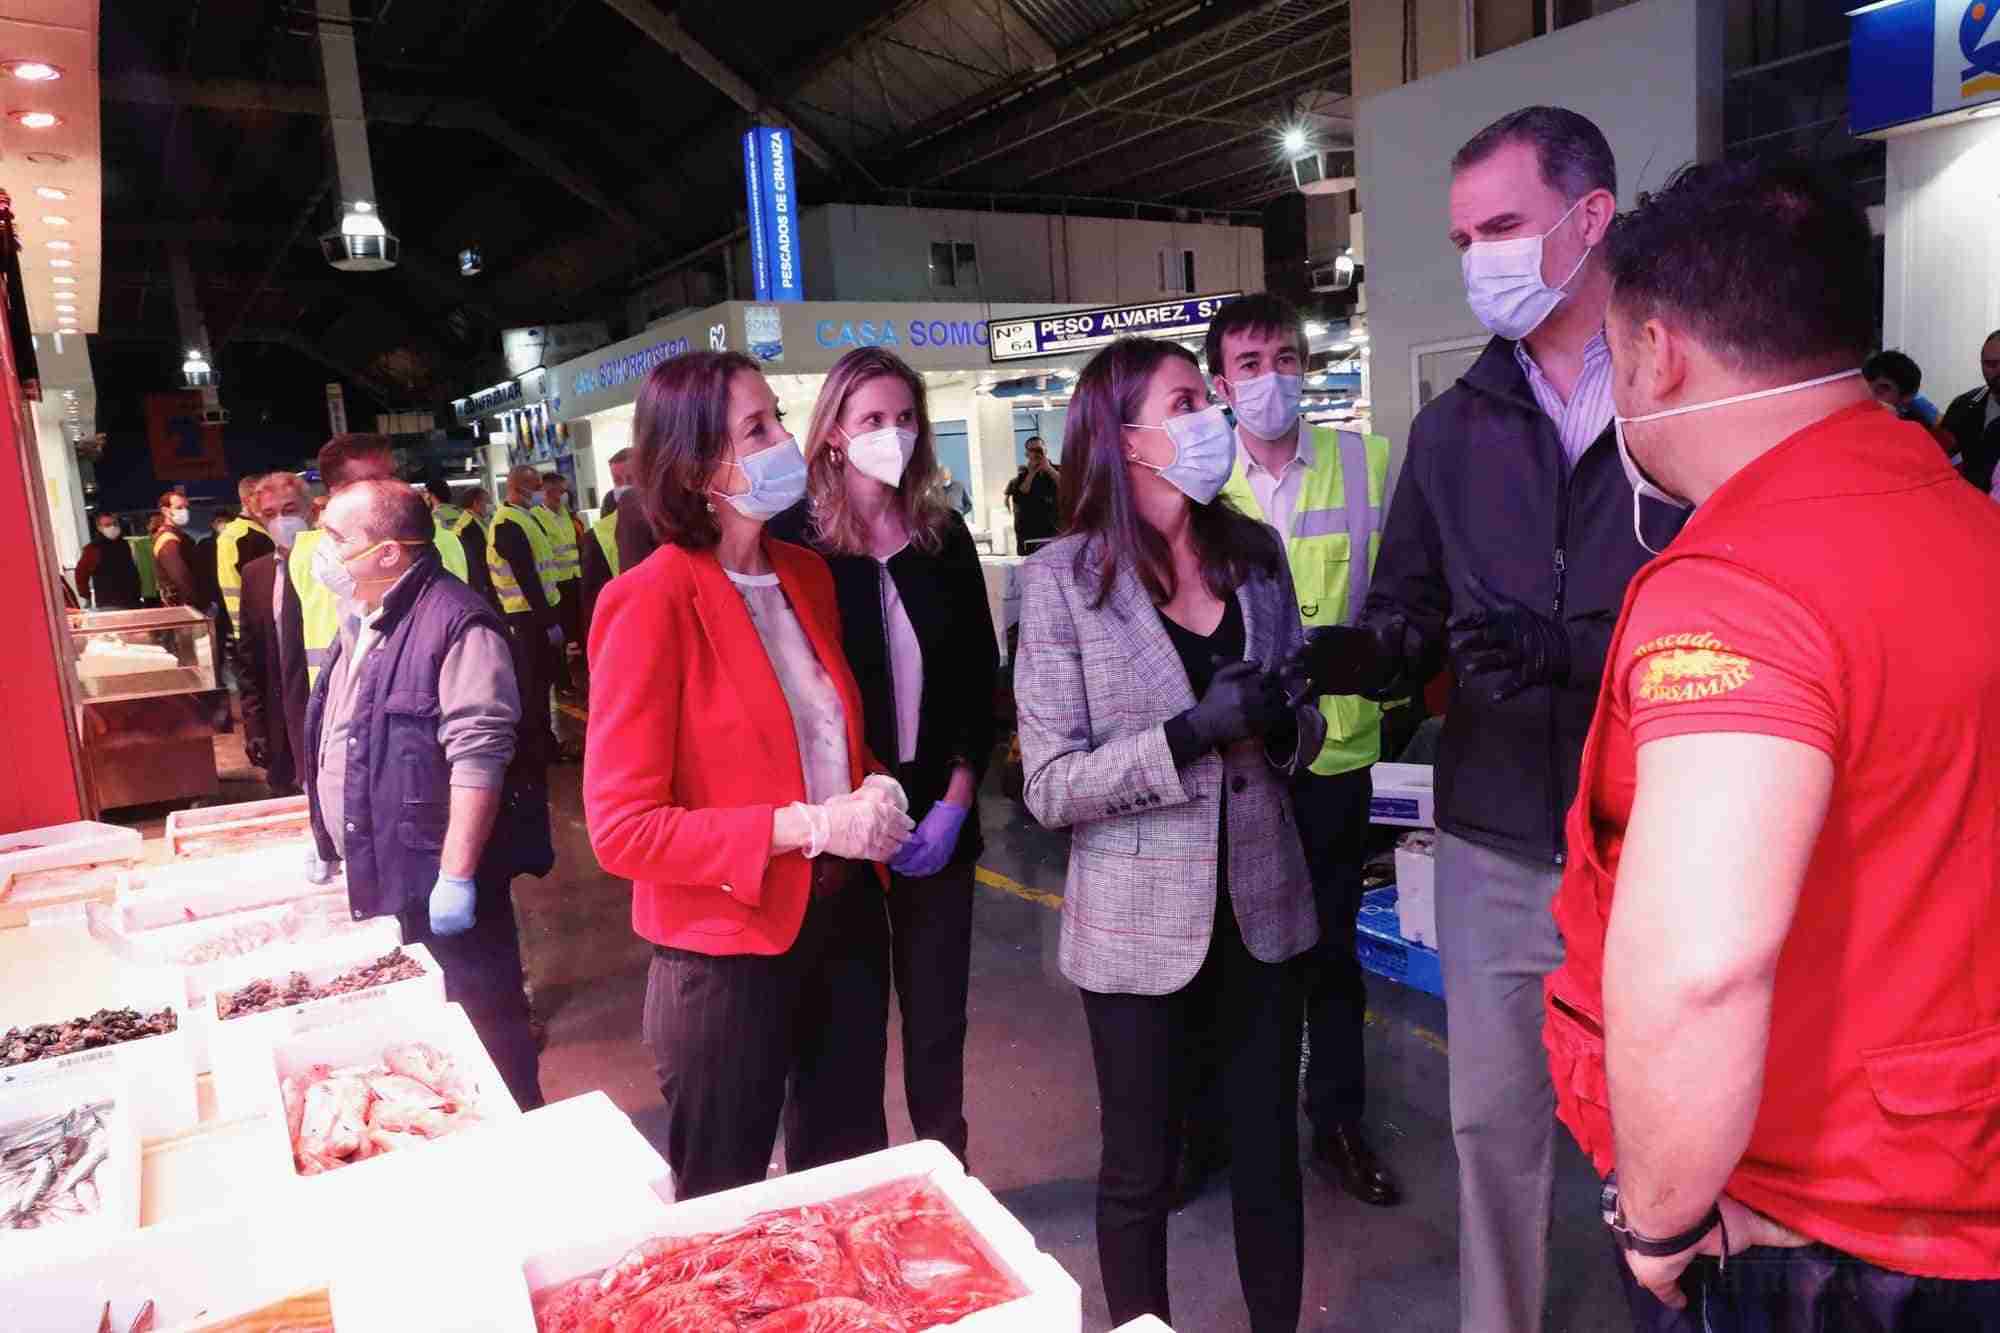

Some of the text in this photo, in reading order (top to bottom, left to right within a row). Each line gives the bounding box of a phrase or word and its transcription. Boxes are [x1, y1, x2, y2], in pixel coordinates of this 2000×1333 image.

[770, 131, 793, 288] PESCADOS DE CRIANZA
[816, 320, 900, 347] CASA
[1040, 316, 1094, 336] PESO
[1101, 304, 1190, 330] ALVAREZ,
[709, 323, 727, 352] 62
[1010, 339, 1033, 352] 64
